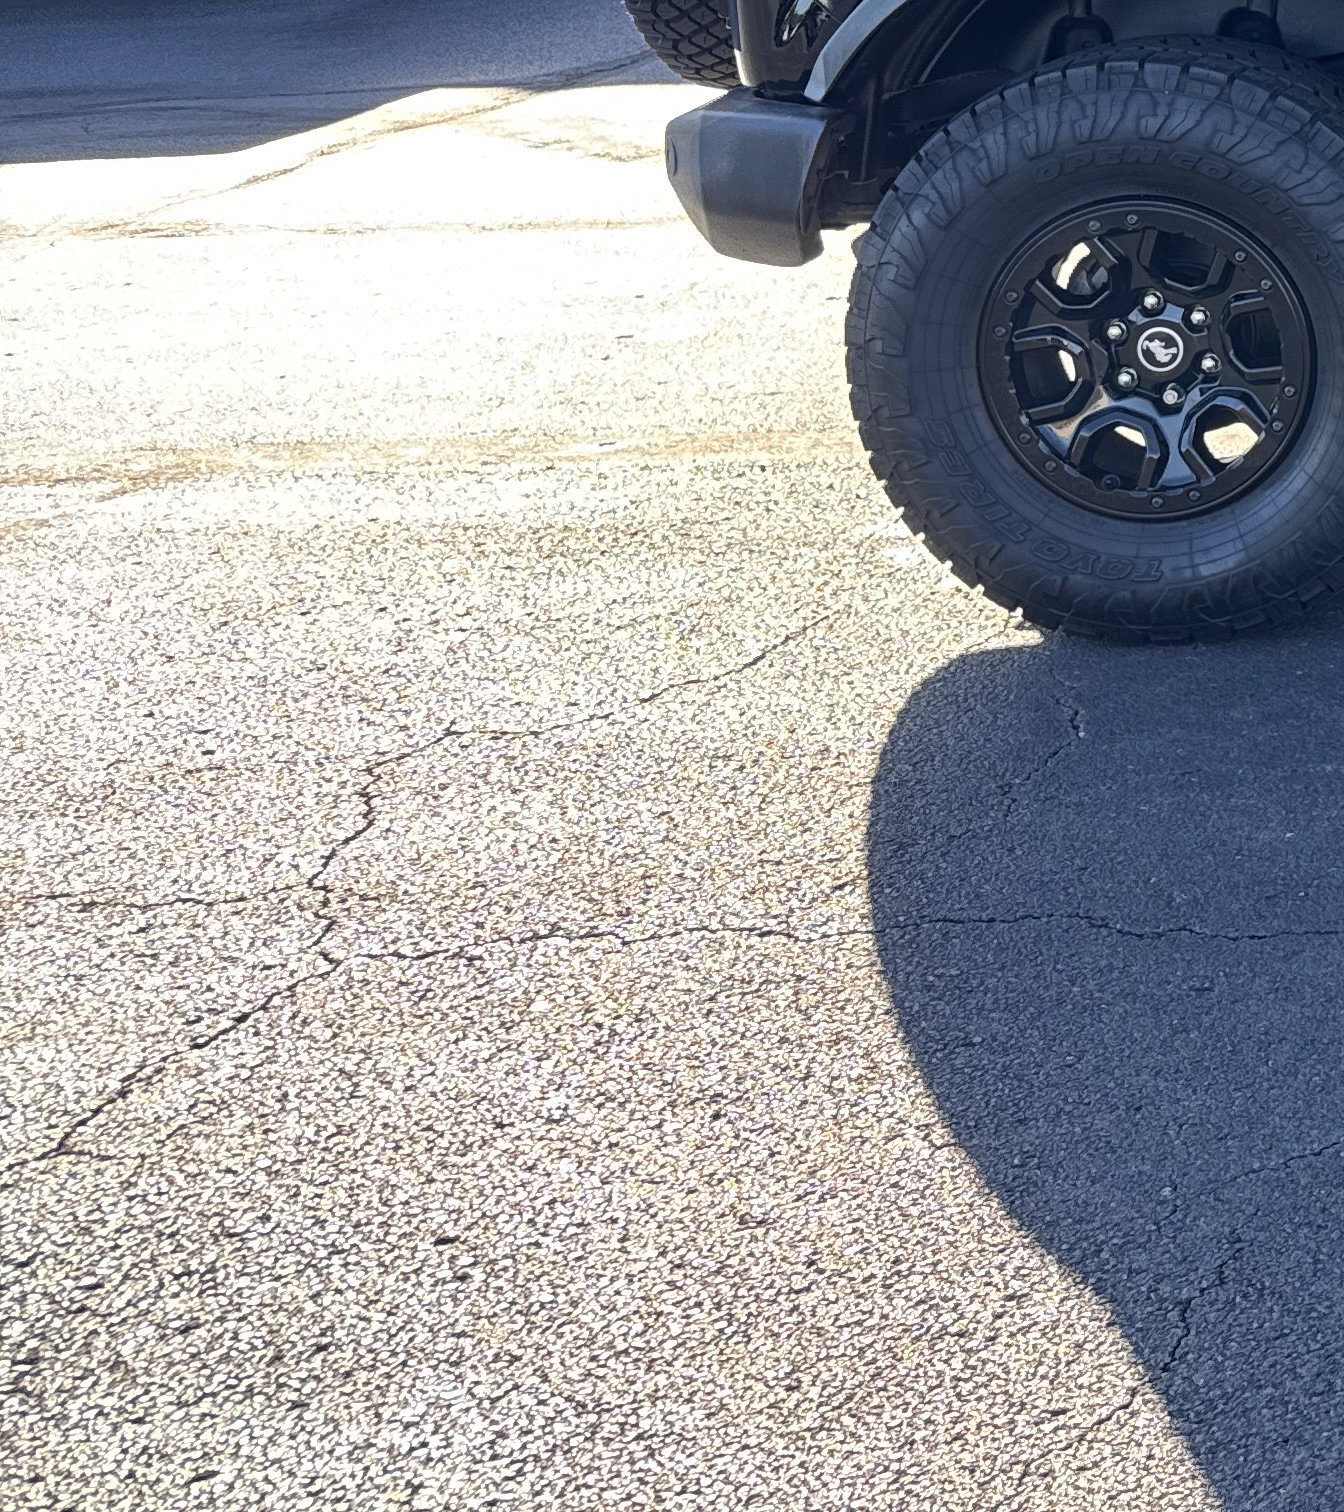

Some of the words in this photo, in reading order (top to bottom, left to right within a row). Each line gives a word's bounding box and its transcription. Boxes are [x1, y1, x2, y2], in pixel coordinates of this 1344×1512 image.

[1031, 144, 1162, 185] OPEN
[922, 419, 1033, 544] TIRES
[1029, 536, 1165, 583] TOYO
